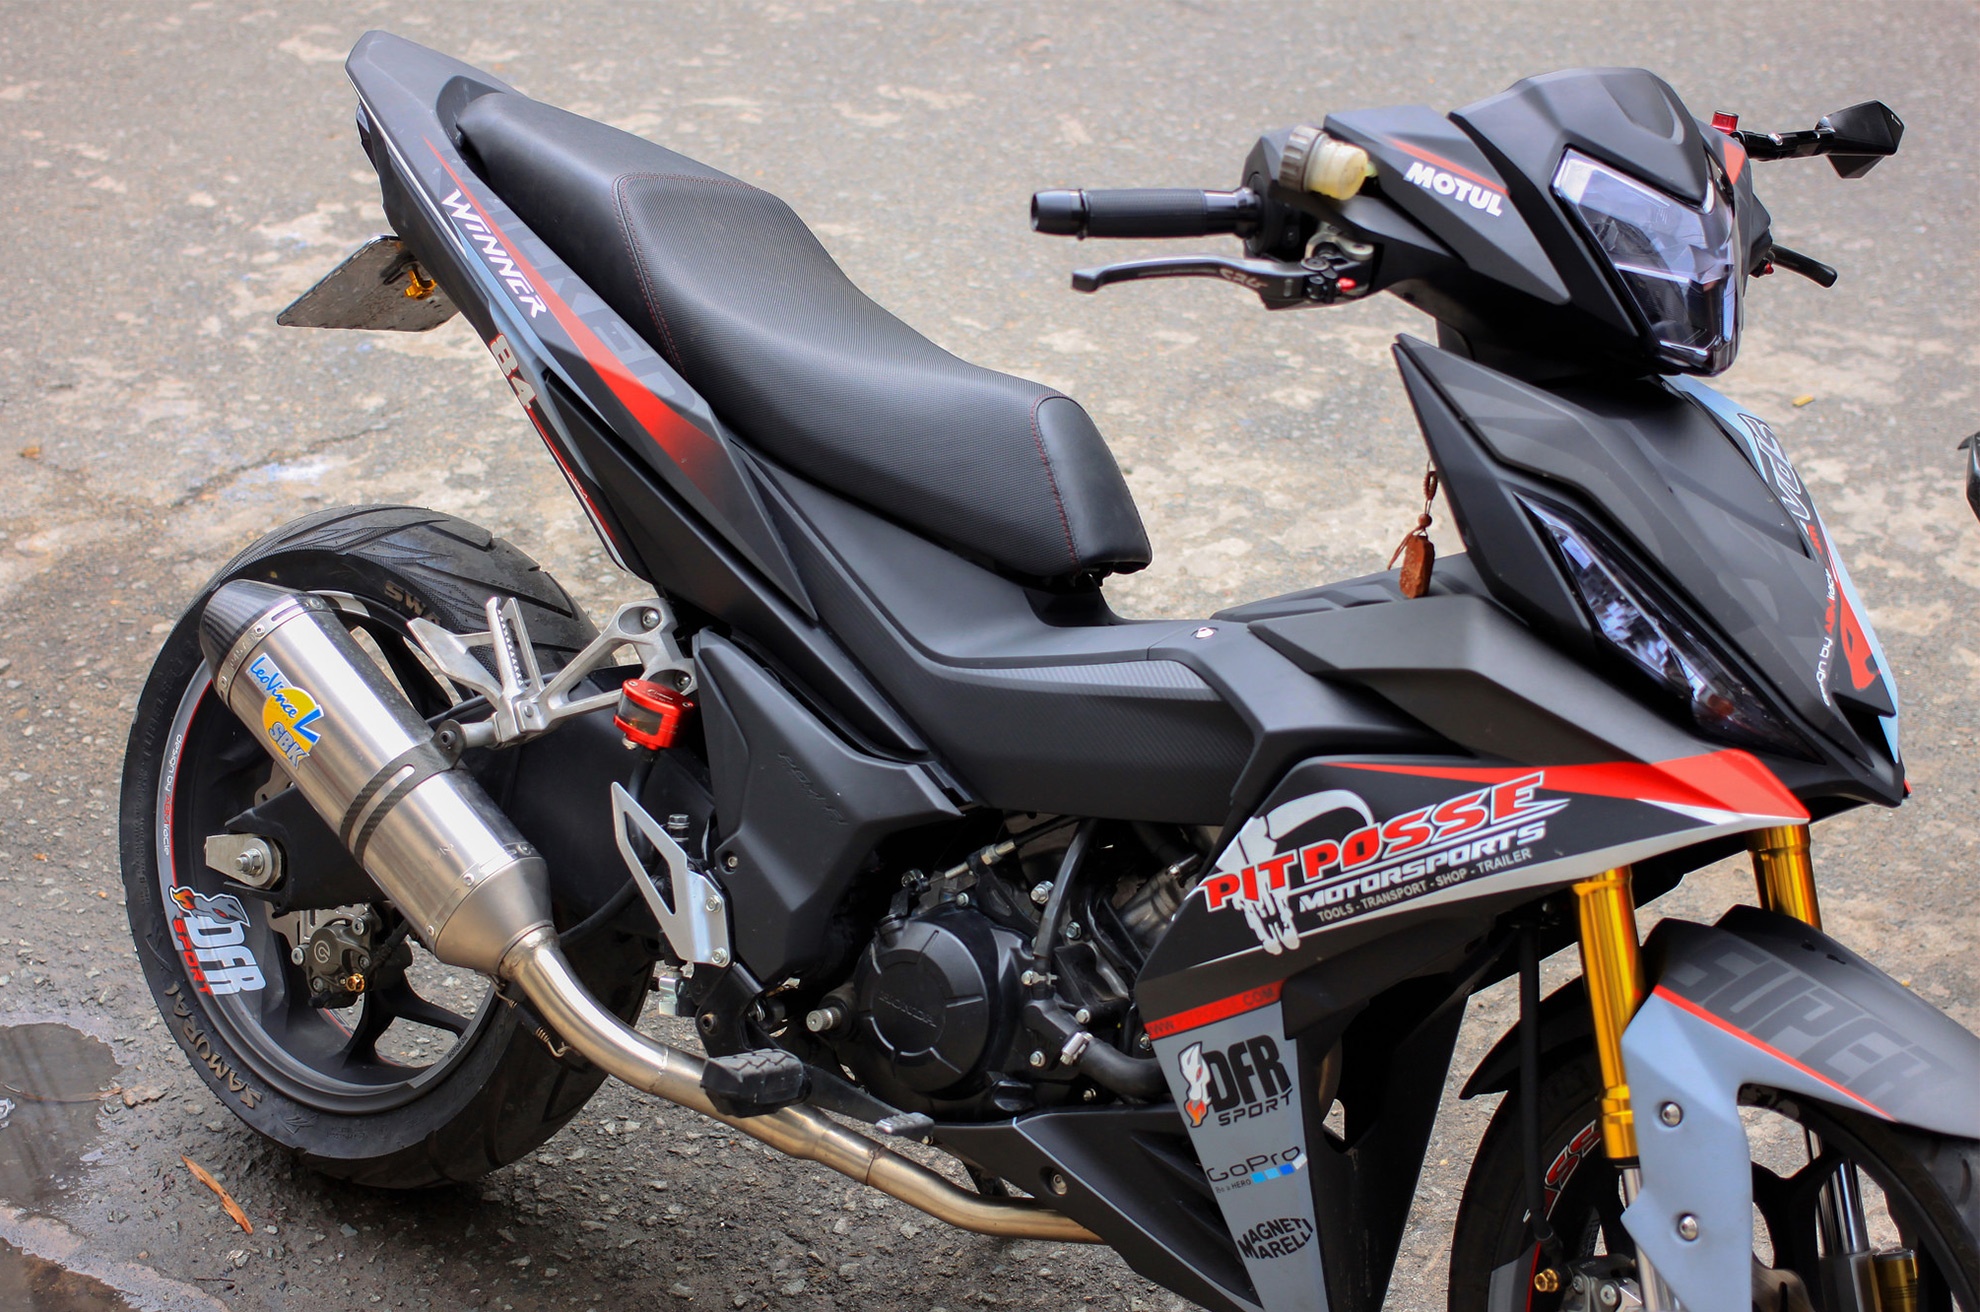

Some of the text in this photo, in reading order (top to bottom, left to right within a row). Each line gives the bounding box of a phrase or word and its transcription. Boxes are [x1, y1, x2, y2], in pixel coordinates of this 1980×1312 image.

[1403, 161, 1503, 217] MOTUL
[440, 188, 547, 319] WINNER
[250, 655, 298, 719] LeoVince
[167, 733, 183, 775] design
[269, 721, 310, 768] SBK
[166, 775, 175, 793] by
[1201, 771, 1552, 912] PIT POSSE
[1299, 821, 1547, 913] MOTORSPORTS
[1317, 903, 1354, 922] TOOLS
[1360, 879, 1428, 910] TRANSPORT
[1435, 867, 1468, 888] SHOP
[1476, 847, 1532, 872] TRAILER
[173, 917, 213, 997] SPORT
[184, 916, 267, 996] DFR
[164, 980, 262, 1110] SAMURAI
[1205, 1034, 1292, 1113] DFR
[1218, 1089, 1293, 1126] SPORT
[1206, 1146, 1301, 1182] GoPro
[1232, 1178, 1252, 1190] HERO
[1237, 1217, 1313, 1257] MAGNETI
